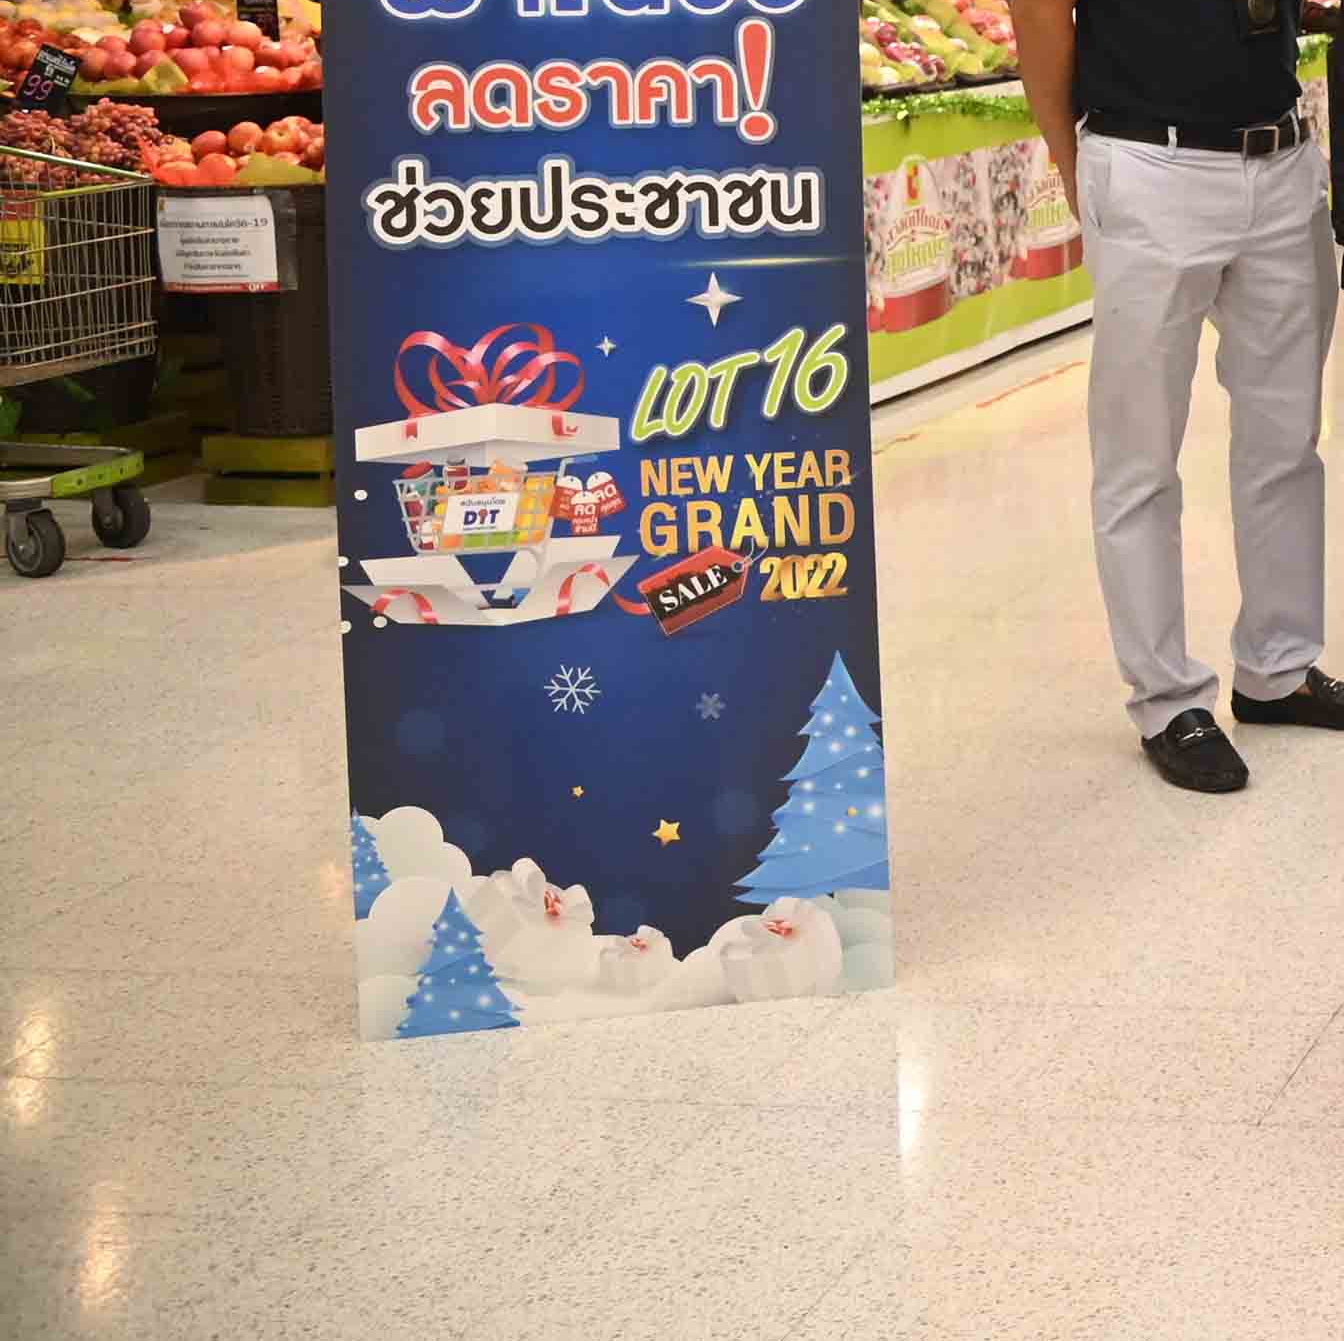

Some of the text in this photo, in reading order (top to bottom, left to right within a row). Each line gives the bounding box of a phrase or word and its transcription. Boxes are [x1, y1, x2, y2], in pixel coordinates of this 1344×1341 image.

[410, 17, 776, 143] ลดราคา!
[368, 160, 820, 243] ช่วยประชาชน
[631, 323, 849, 443] LOT 16
[639, 449, 852, 497] NEW YEAR
[639, 493, 856, 557] GRAND
[657, 564, 726, 615] SALE
[759, 553, 849, 602] 2022
